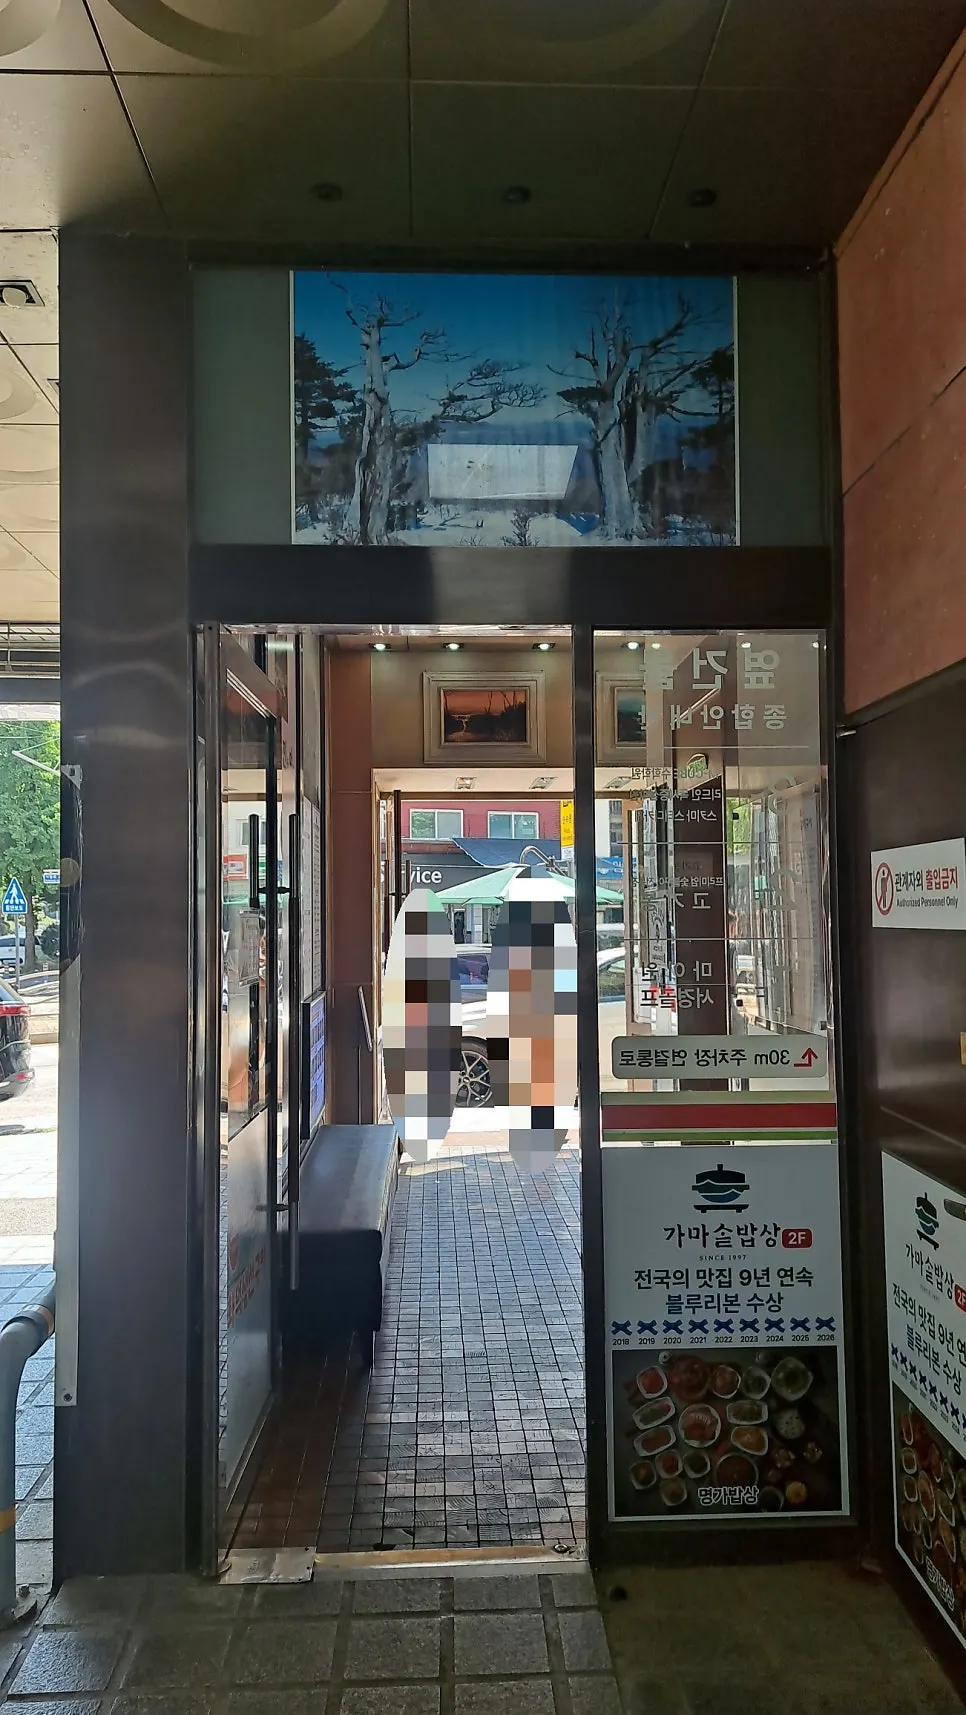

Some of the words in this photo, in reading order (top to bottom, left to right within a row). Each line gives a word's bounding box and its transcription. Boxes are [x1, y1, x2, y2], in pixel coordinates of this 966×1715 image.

[895, 870, 924, 893] 관계자외
[925, 866, 958, 891] 출입금지
[896, 897, 920, 908] Authorized
[921, 896, 945, 908] Personnel
[946, 895, 958, 908] Only
[663, 1222, 781, 1249] 가마솥밥상
[788, 1231, 806, 1245] 2F
[699, 1254, 725, 1262] SINCE
[634, 1268, 689, 1290] 전국의
[696, 1267, 732, 1289] 맛집
[739, 1267, 771, 1288] 9년
[776, 1266, 814, 1288] 연속
[905, 1243, 954, 1300] 가마솥밥상
[666, 1294, 741, 1315] 블루리본
[746, 1292, 784, 1313] 수상
[893, 1283, 916, 1323] 전국의
[918, 1304, 936, 1340] 맛집
[938, 1323, 954, 1356] 9년
[613, 1338, 630, 1346] 2018
[638, 1337, 656, 1345] 2019
[690, 1336, 707, 1344] 2021
[740, 1335, 759, 1343] 2023
[791, 1334, 810, 1342] 2025
[906, 1323, 940, 1376] 블루리본
[943, 1359, 962, 1396] 수상
[698, 1486, 759, 1506] 명가밥상
